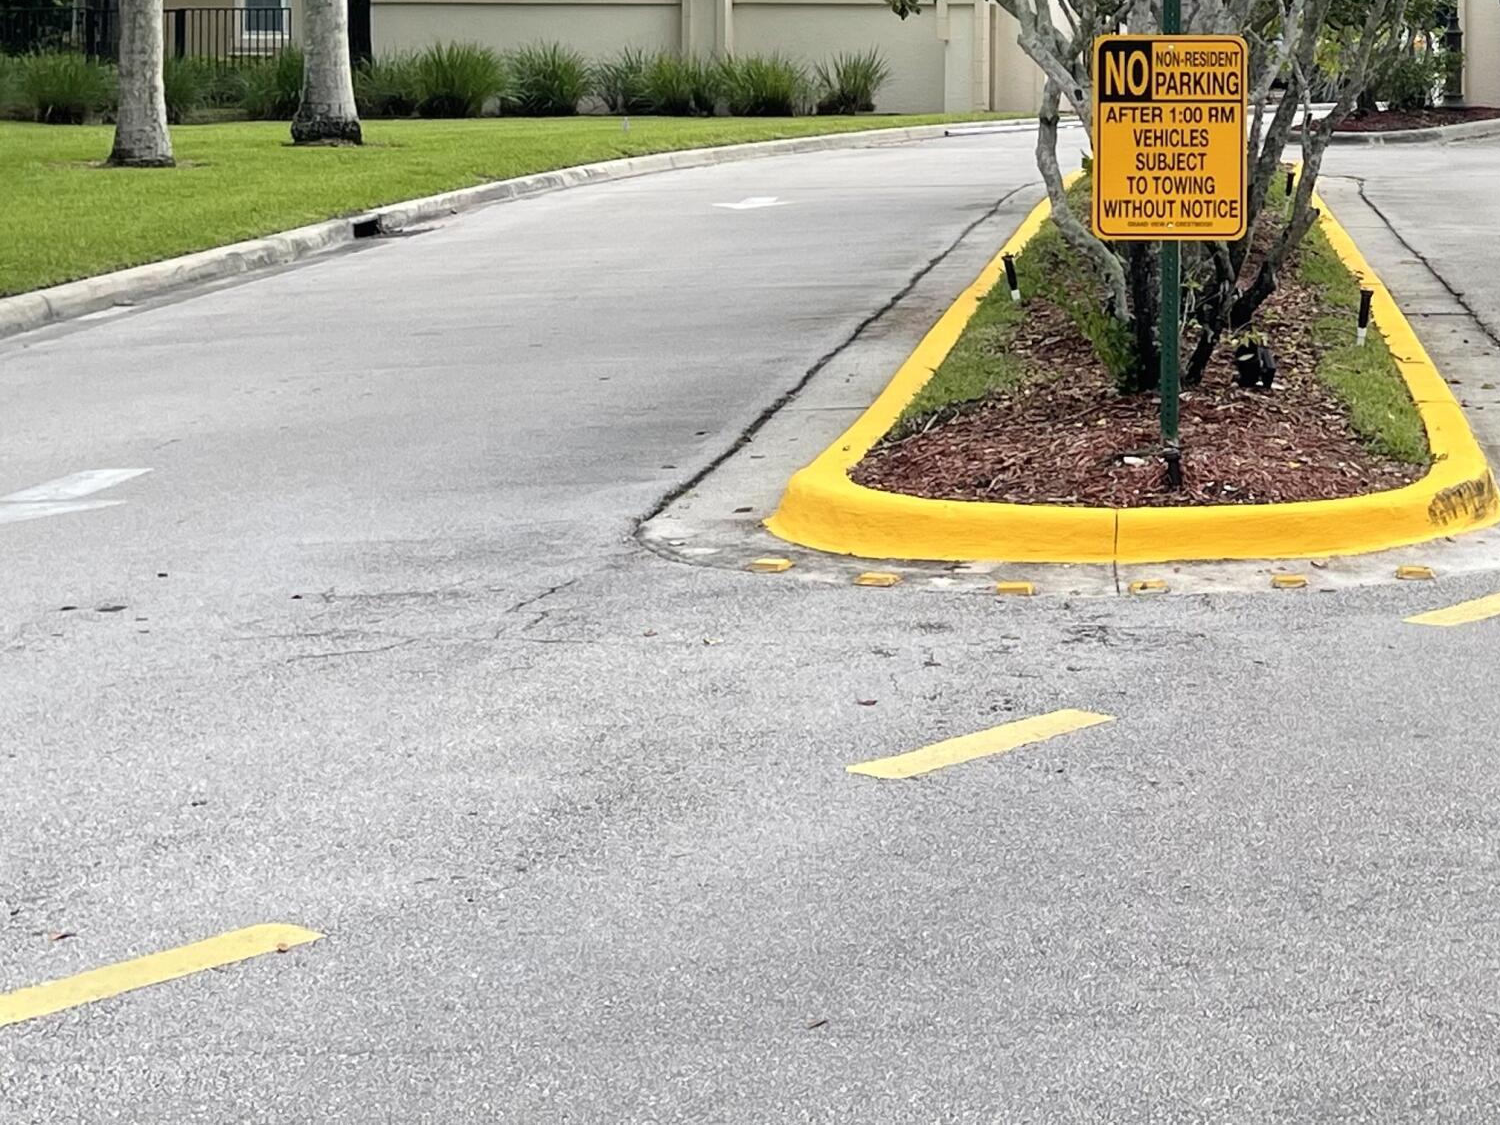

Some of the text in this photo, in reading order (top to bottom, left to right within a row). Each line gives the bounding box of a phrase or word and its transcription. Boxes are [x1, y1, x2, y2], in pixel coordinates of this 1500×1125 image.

[1155, 51, 1239, 67] NON-RESIDENT
[1105, 50, 1149, 96] NO
[1155, 72, 1239, 96] PARKING
[1106, 107, 1163, 123] AFTER
[1169, 106, 1203, 123] 1:00
[1133, 128, 1209, 147] VEHICLES
[1135, 153, 1207, 171] SUBJECT
[1127, 176, 1216, 194] TO TOWING
[1103, 200, 1238, 218] WITHOUT NOTICE
